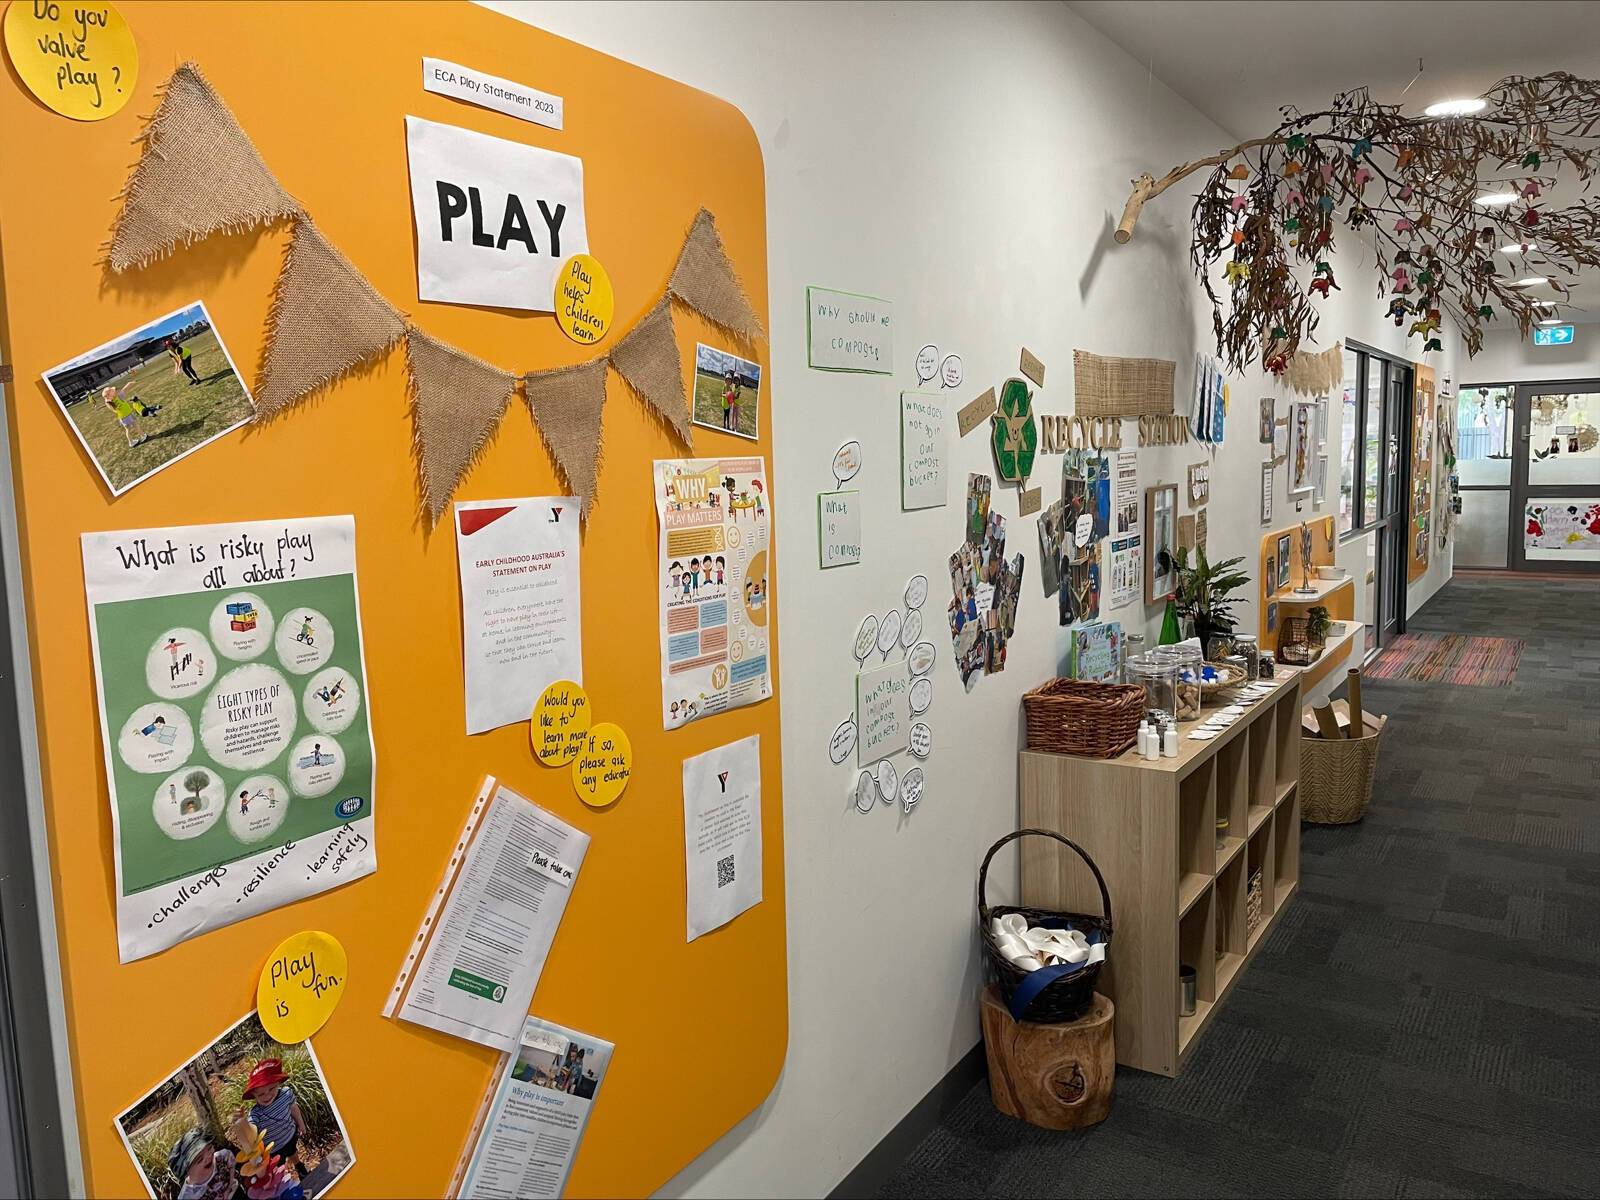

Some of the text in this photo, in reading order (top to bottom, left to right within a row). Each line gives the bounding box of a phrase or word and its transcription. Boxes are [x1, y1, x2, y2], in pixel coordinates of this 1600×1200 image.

[435, 68, 554, 114] ECA Play Statement 2023
[436, 180, 567, 258] PLAY
[572, 260, 592, 295] Play
[563, 282, 585, 308] helps
[909, 419, 922, 430] not
[1041, 414, 1189, 453] RECYCLE STATION
[676, 478, 705, 500] WHY
[825, 500, 848, 515] What
[666, 510, 722, 526] PLAY MATTERS
[828, 522, 835, 535] is
[116, 529, 314, 571] What is risky play
[476, 550, 565, 568] EARLY CHILDHOOD AUSTRALIA'S
[203, 566, 227, 589] all
[493, 566, 527, 577] STATEMENT
[539, 563, 552, 571] PLAY
[217, 685, 279, 709] EIGHT TYPES OF
[544, 688, 569, 707] Would
[228, 702, 273, 722] RISKY PLAY
[540, 711, 568, 727] like to
[224, 732, 244, 741] children
[251, 726, 269, 737] manage
[270, 723, 280, 731] risks
[225, 725, 238, 734] Risky
[239, 724, 249, 732] play
[259, 717, 278, 727] support
[225, 744, 252, 754] themselves
[262, 736, 281, 745] develop
[257, 730, 279, 741] challenge
[543, 730, 563, 743] learn
[539, 743, 560, 759] about
[579, 753, 625, 774] please ask
[581, 775, 597, 793] any
[331, 833, 368, 873] safely
[271, 951, 317, 989] Play
[275, 998, 289, 1018] is
[512, 1086, 523, 1097] Why
[523, 1089, 534, 1100] play
[540, 1095, 565, 1107] important
